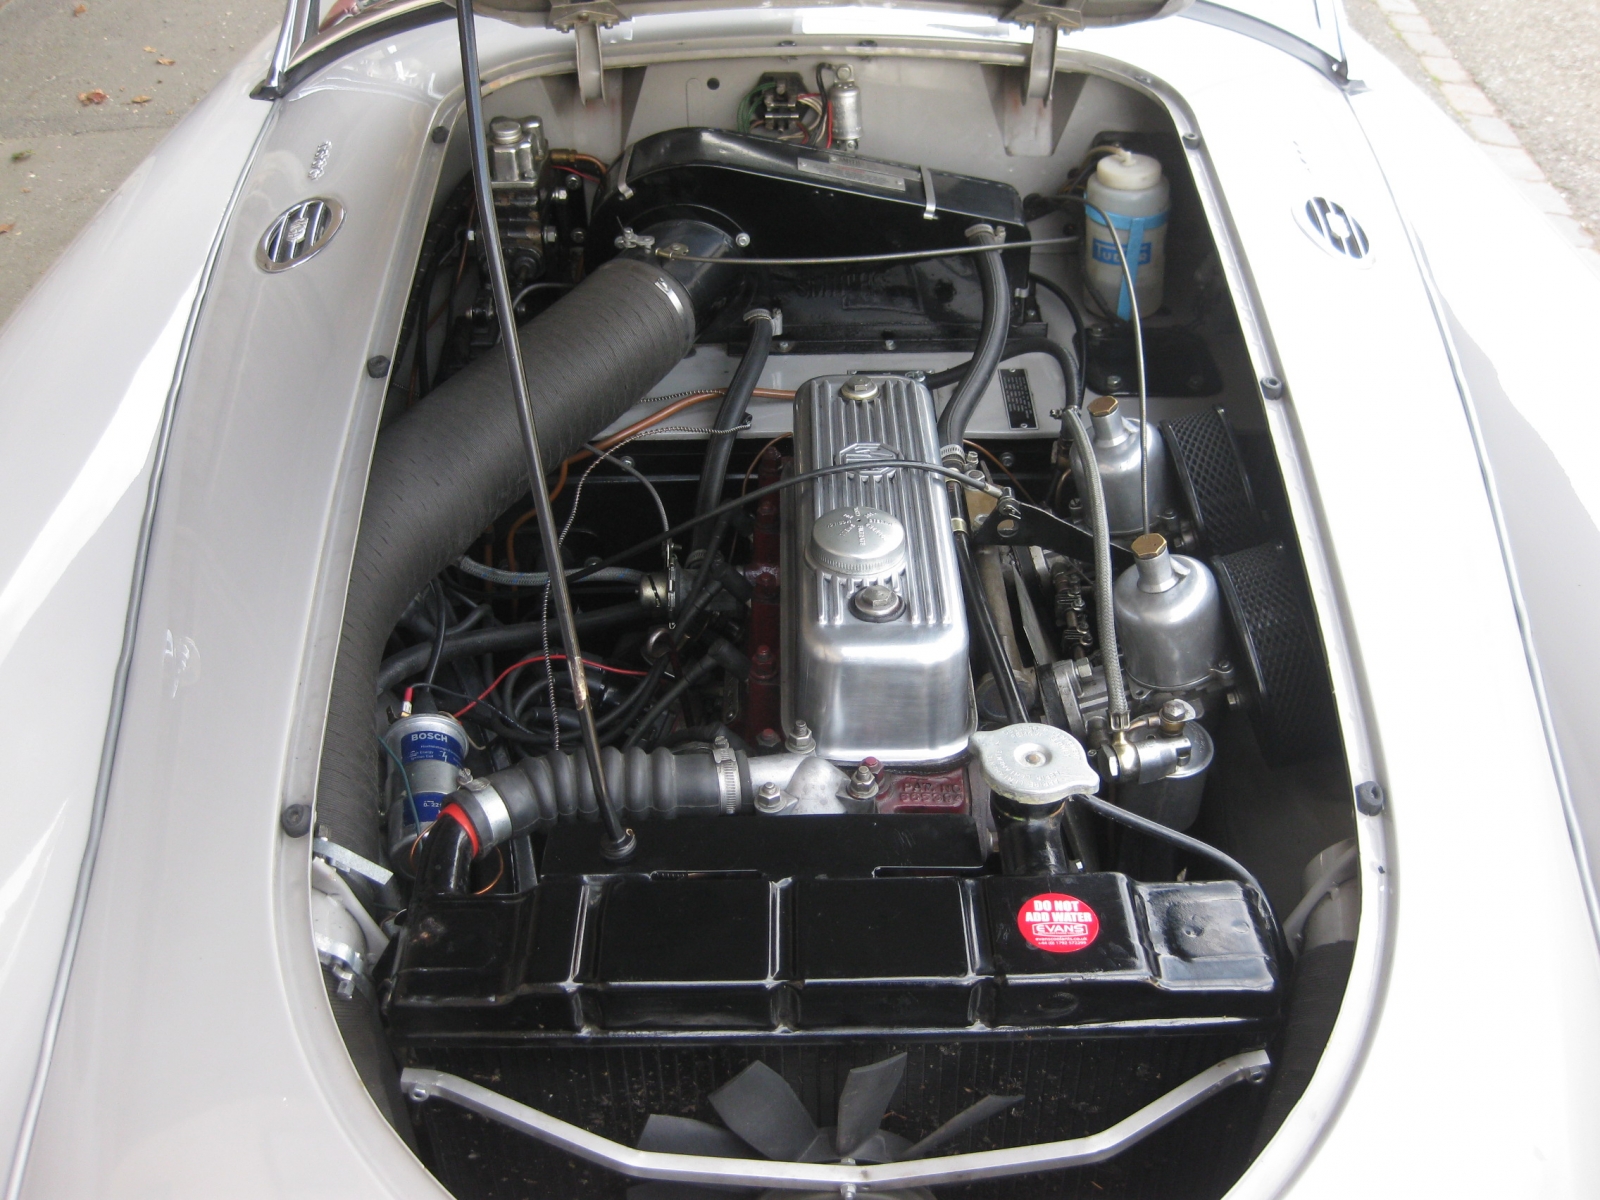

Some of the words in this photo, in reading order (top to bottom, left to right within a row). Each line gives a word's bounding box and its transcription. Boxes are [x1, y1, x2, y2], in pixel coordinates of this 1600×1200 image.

[1095, 241, 1147, 263] TUDR
[411, 732, 448, 743] BOSCH
[1033, 900, 1052, 912] DO
[1054, 900, 1079, 912] NOT
[1025, 911, 1050, 922] ADD
[1052, 911, 1093, 922] WATER
[1036, 924, 1085, 933] EVANS
